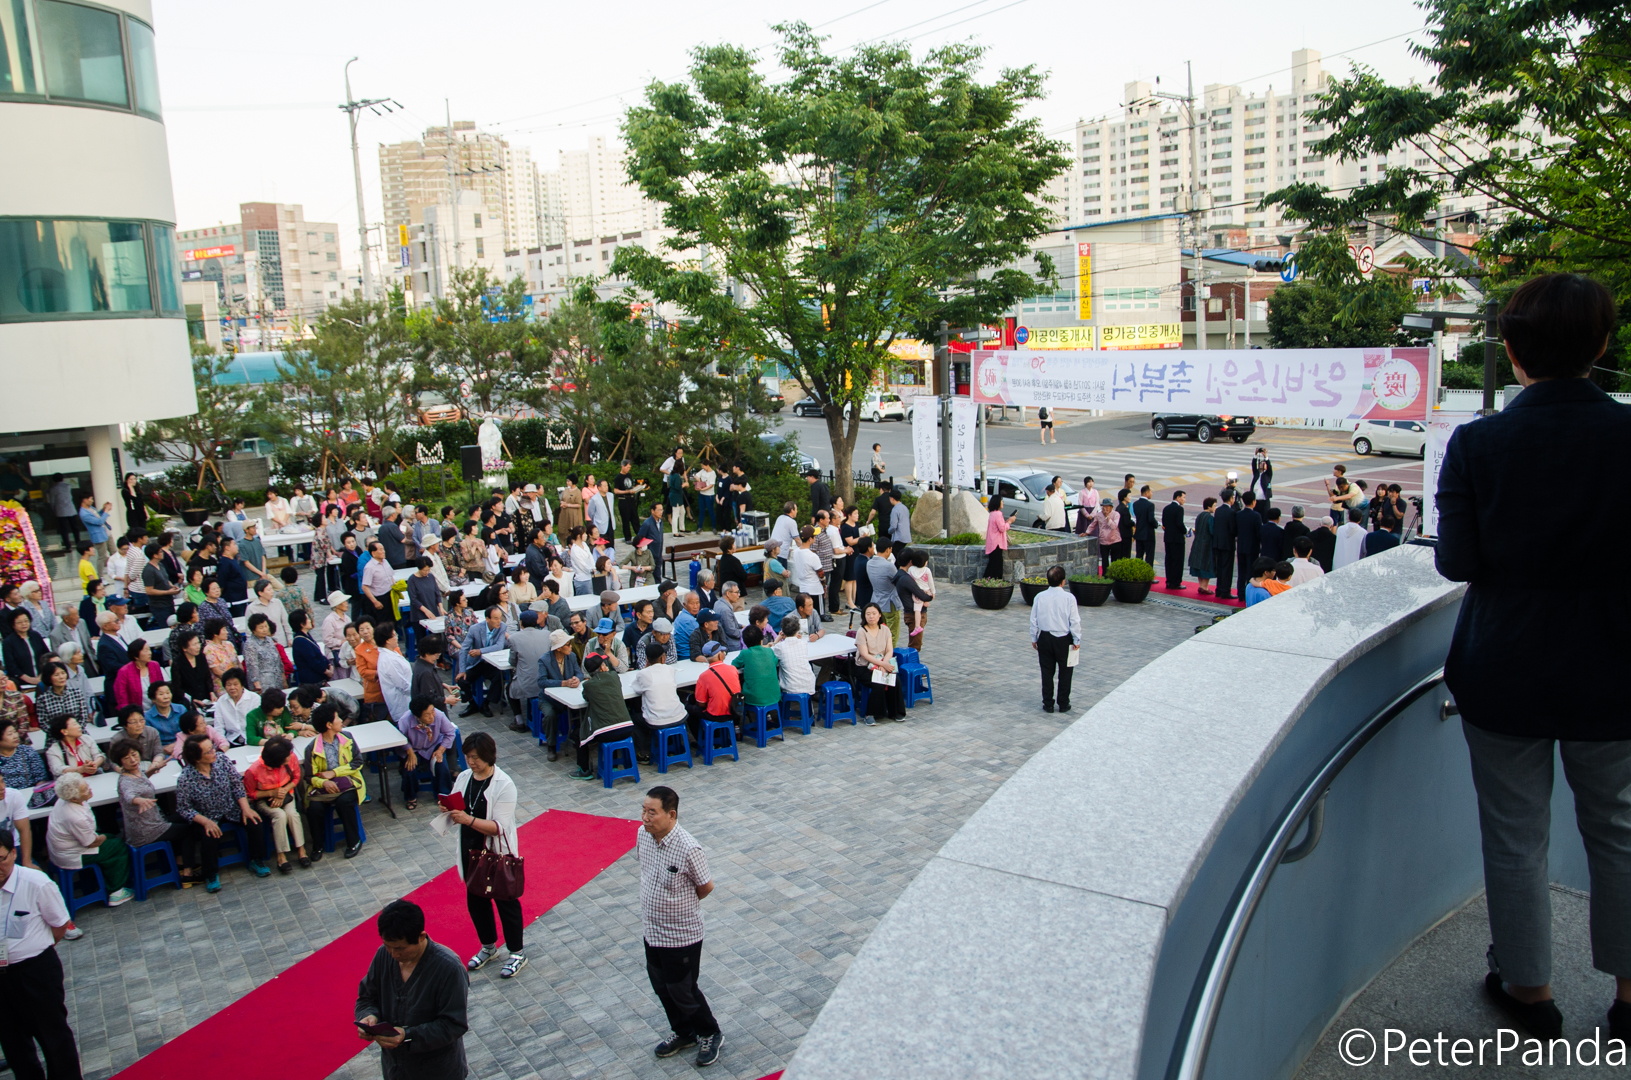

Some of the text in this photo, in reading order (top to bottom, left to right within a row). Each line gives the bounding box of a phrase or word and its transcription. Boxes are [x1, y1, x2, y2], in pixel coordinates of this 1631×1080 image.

[1080, 244, 1089, 256] 땅
[1029, 328, 1092, 343] 가공인중개사
[1103, 324, 1181, 341] 명가공인중개사
